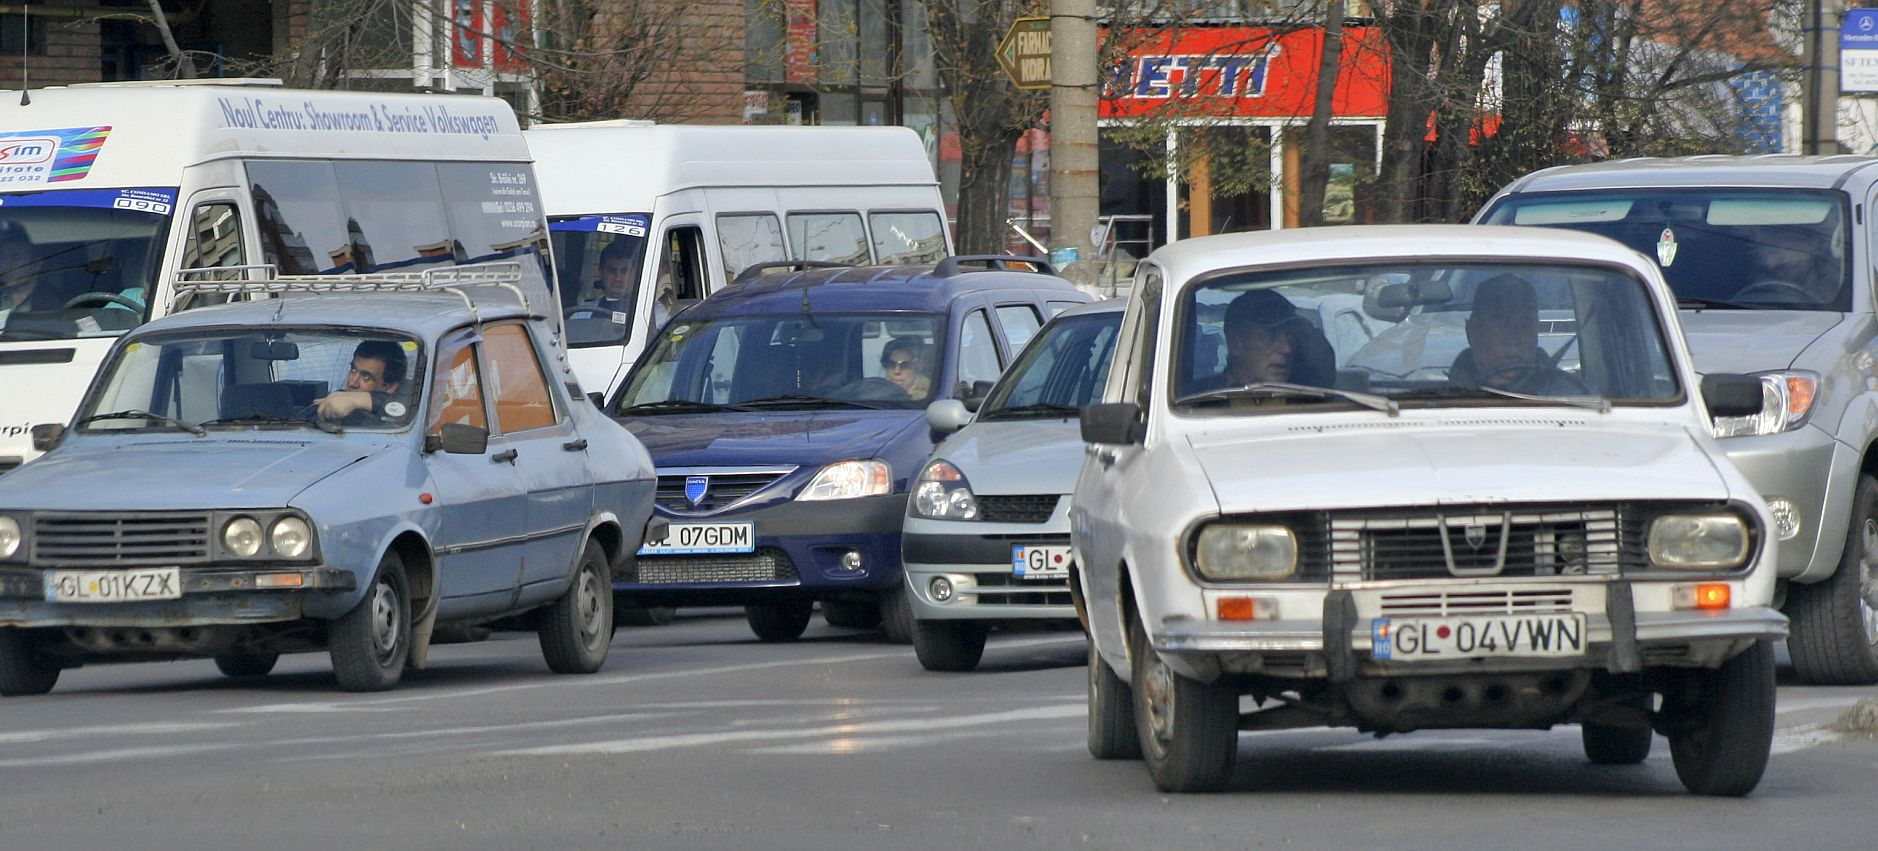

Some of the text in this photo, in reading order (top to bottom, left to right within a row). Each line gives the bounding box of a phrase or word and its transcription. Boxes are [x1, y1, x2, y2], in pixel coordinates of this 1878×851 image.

[217, 97, 499, 140] Noul Centru: Showroom & Service Volkswagen
[117, 199, 167, 212] 090
[602, 224, 640, 235] 126
[680, 526, 748, 546] 07GDM
[1029, 549, 1058, 570] GL
[61, 576, 89, 598] GL
[99, 573, 174, 597] 01KZX
[1395, 618, 1580, 654] GL 04VWN
